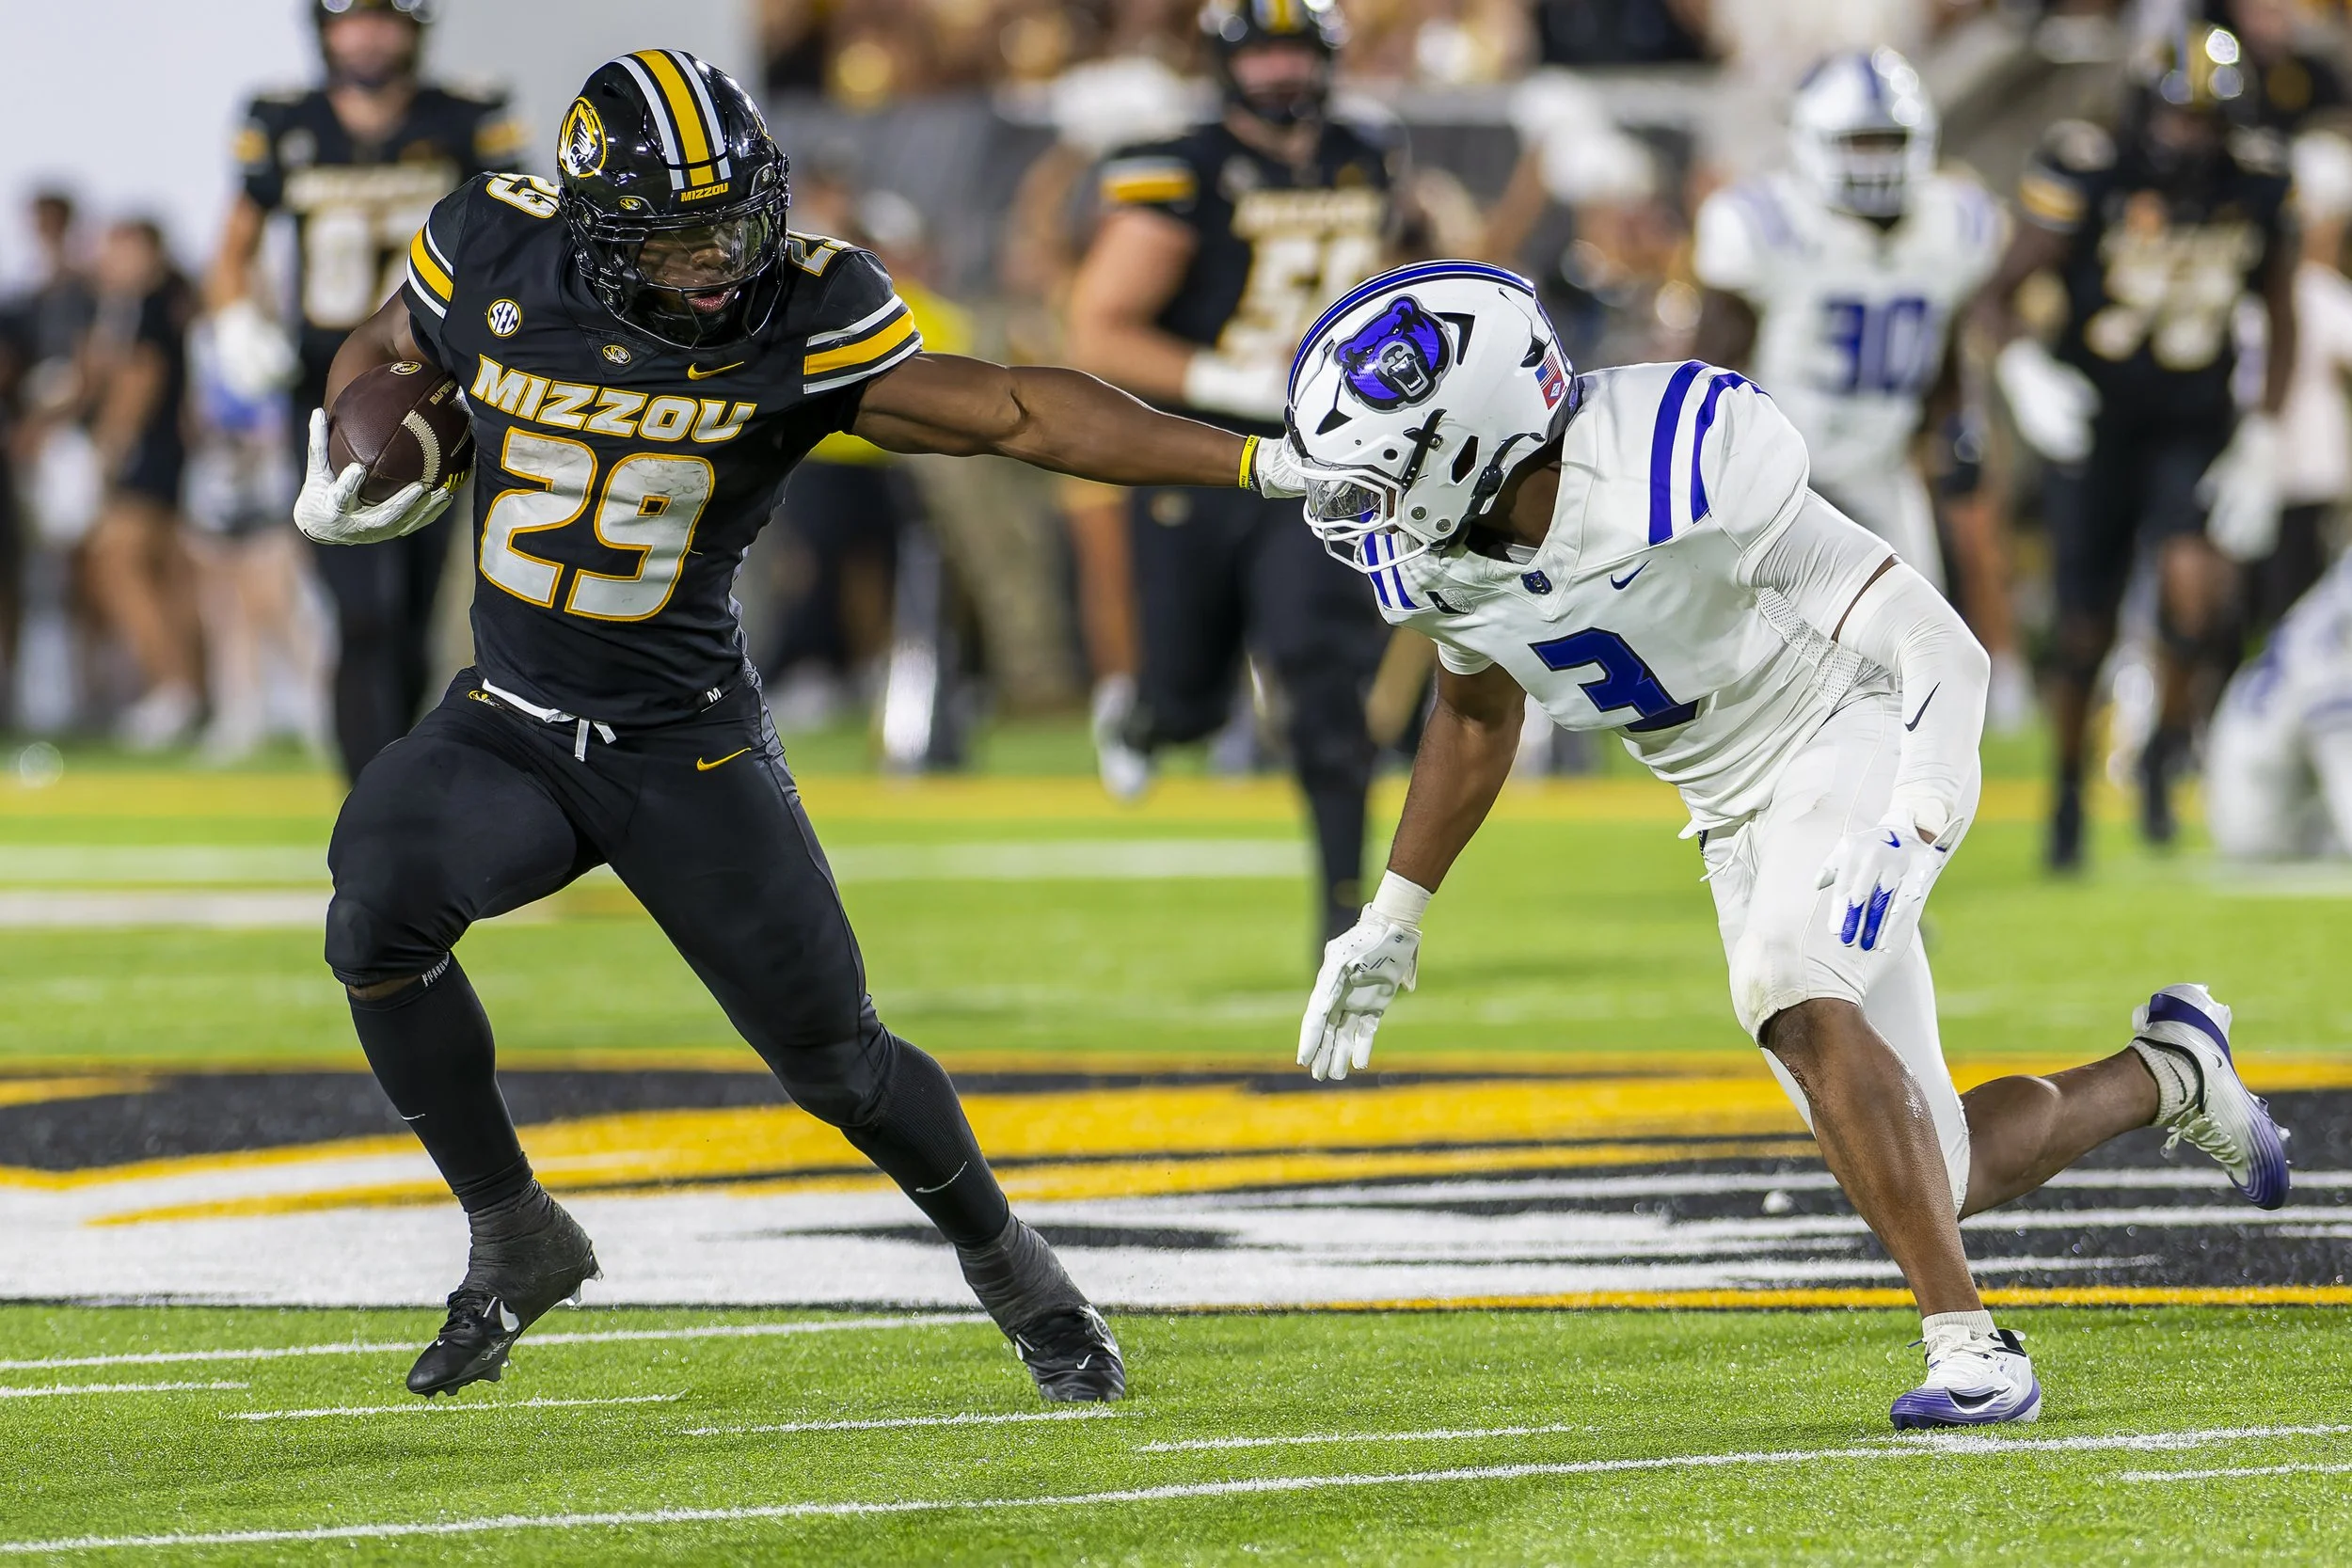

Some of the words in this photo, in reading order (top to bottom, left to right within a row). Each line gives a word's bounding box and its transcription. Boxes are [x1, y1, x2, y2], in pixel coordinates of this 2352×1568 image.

[680, 182, 729, 202] MIZZOU
[489, 301, 518, 335] SEC
[1818, 293, 1932, 395] 30
[470, 354, 756, 443] MIZZOU
[479, 427, 715, 623] 29
[1529, 627, 1699, 732] 3
